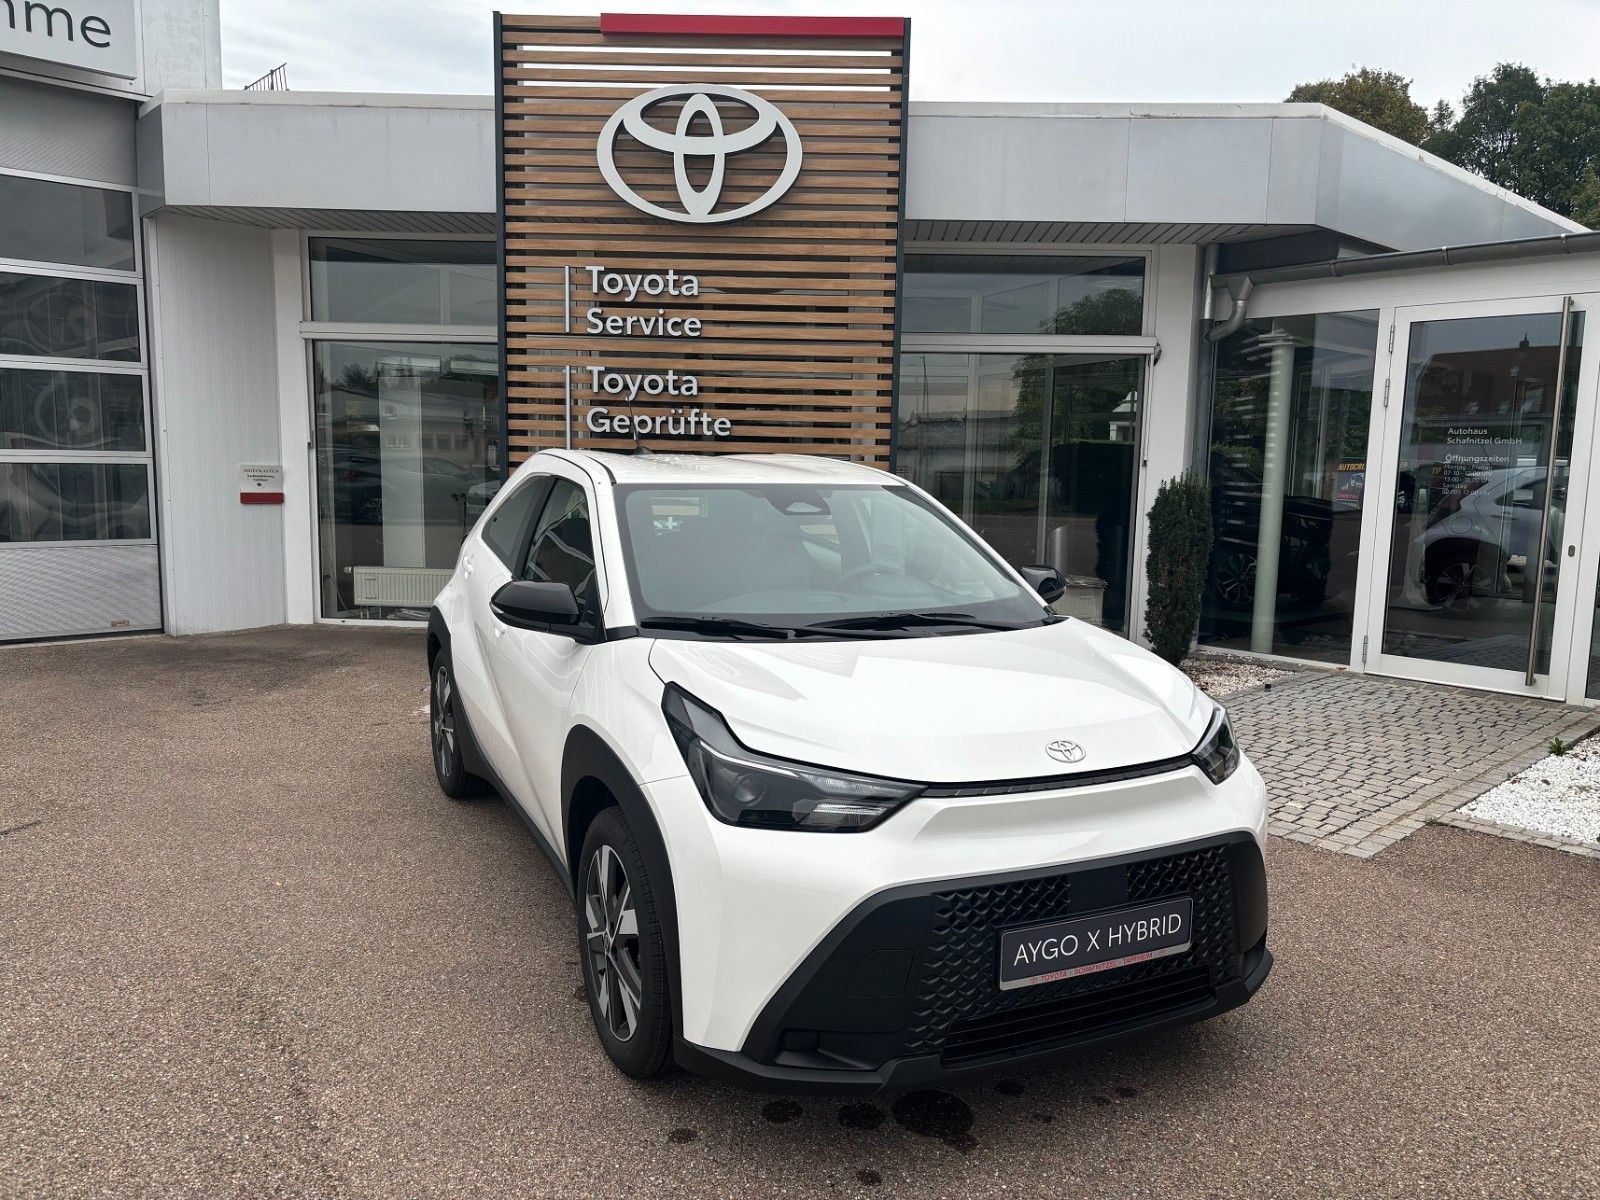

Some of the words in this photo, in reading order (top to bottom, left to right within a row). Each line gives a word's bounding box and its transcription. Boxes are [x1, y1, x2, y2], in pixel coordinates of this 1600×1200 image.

[586, 266, 699, 302] Toyota
[586, 308, 702, 336] Service
[586, 366, 698, 401] Toyota
[586, 408, 731, 440] Geprüfte
[1446, 437, 1493, 445] Schafnitzel
[1494, 437, 1522, 445] GmbH
[1337, 463, 1366, 471] AUTOCR
[1445, 453, 1510, 463] Öffnungszeiten
[1013, 934, 1079, 966] AYGO
[1086, 929, 1101, 951] X
[1108, 913, 1182, 947] HYBRID
[1040, 970, 1068, 981] TOYOTA
[1074, 961, 1118, 976] SCHAFNITZEL
